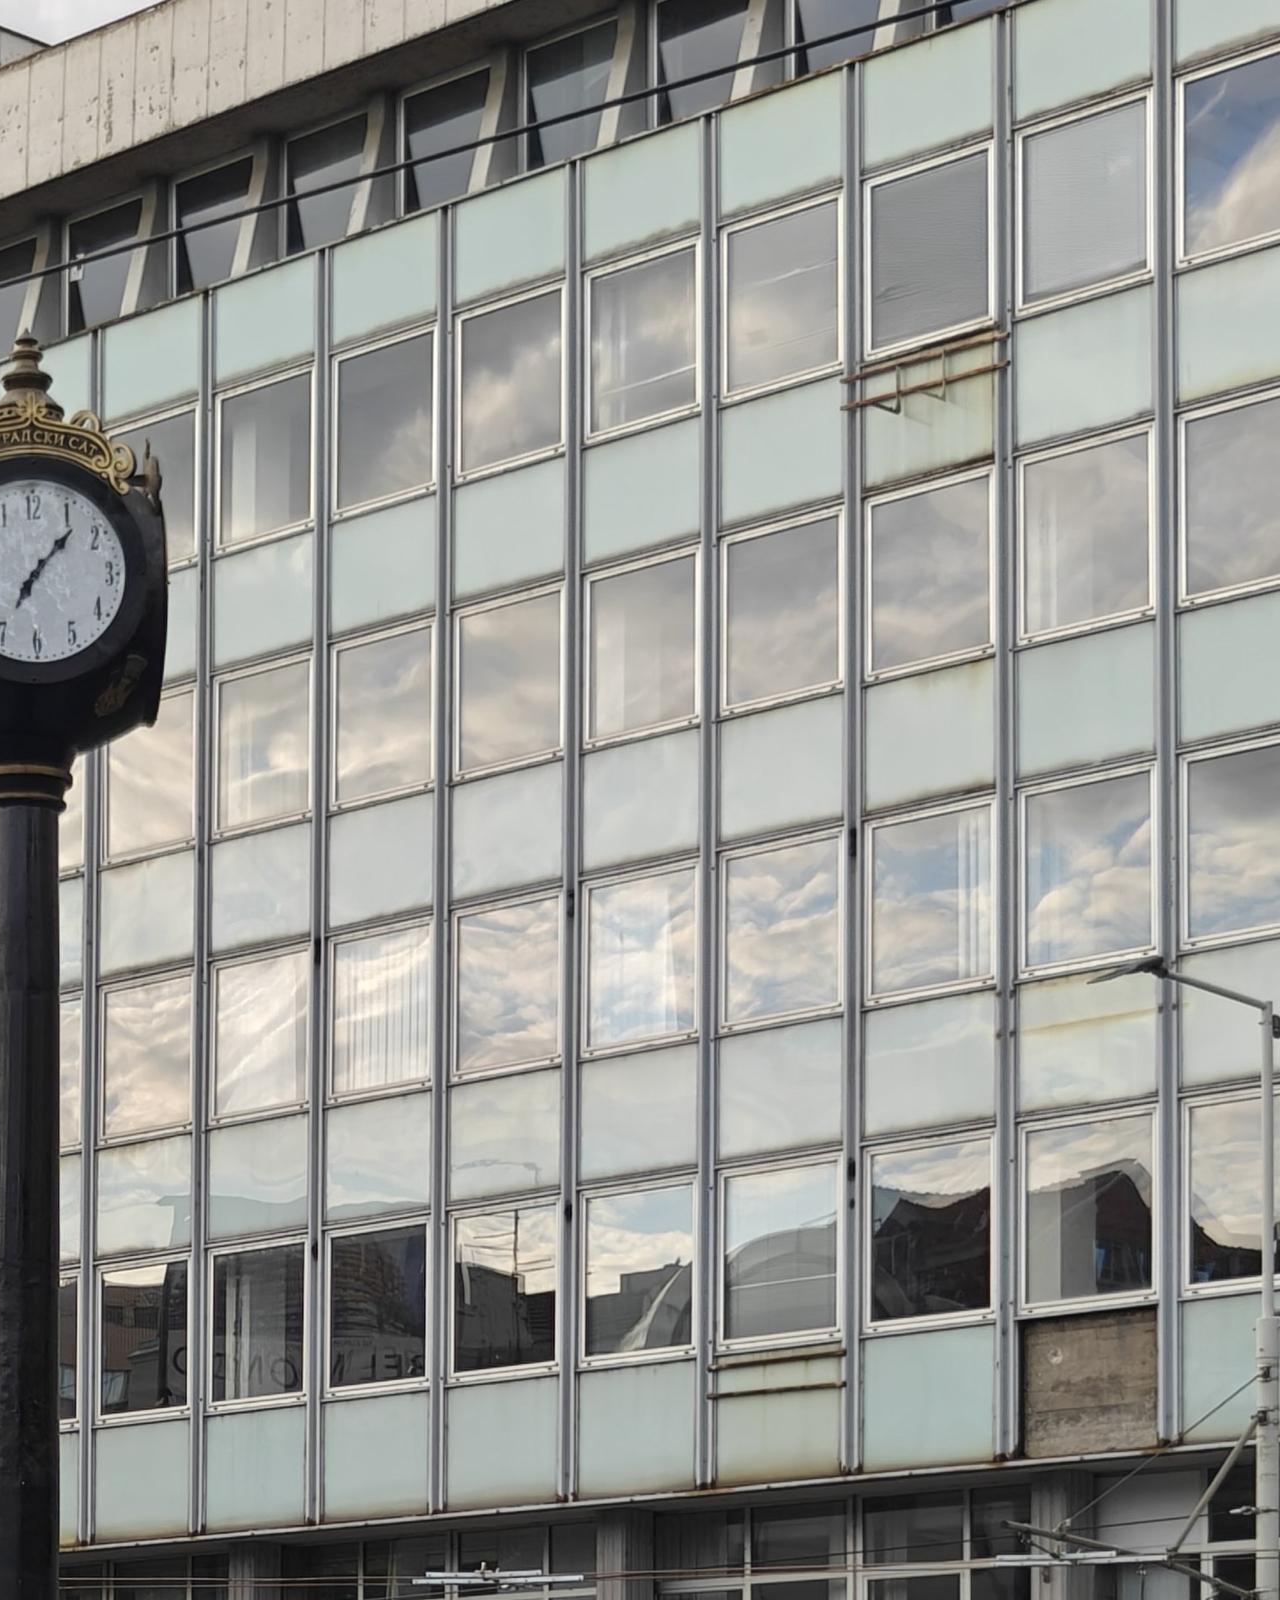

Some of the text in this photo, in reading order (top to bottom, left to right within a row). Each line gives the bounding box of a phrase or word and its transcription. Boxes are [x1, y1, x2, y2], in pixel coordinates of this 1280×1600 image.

[68, 436, 98, 456] САТ
[25, 495, 41, 520] 12
[64, 502, 71, 528] 1
[91, 526, 100, 551] 2
[105, 562, 114, 586] 3
[94, 596, 102, 621] 4
[0, 622, 7, 647] 7
[32, 629, 42, 654] 6
[68, 621, 76, 646] 5
